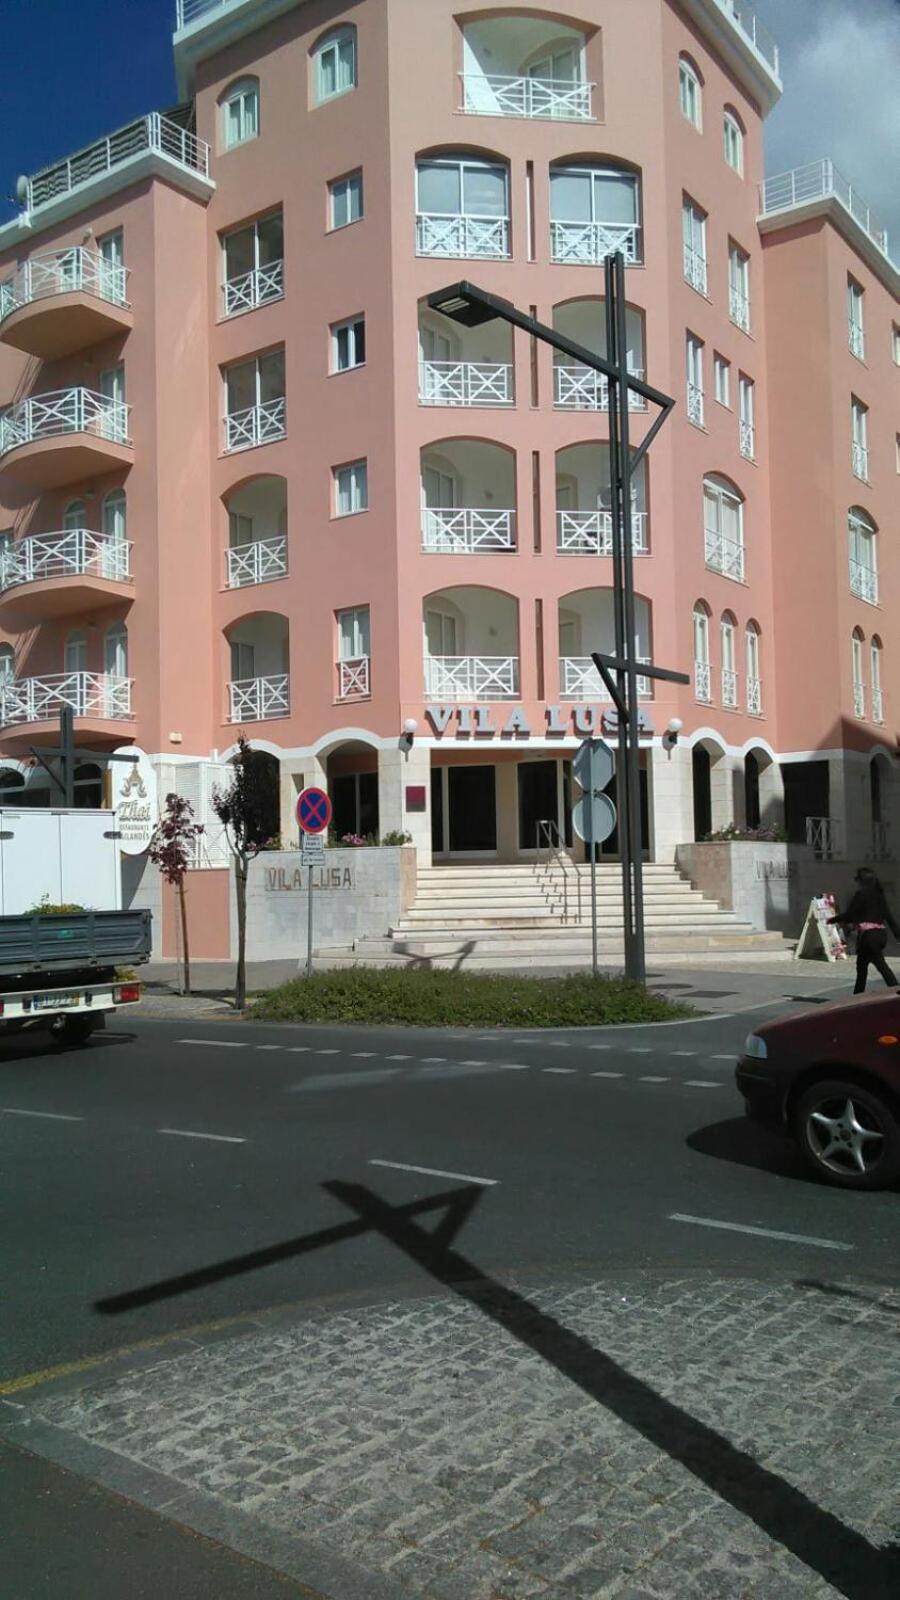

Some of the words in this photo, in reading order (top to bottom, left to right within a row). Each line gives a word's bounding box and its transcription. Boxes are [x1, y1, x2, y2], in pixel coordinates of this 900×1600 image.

[425, 704, 530, 736] VILA
[546, 704, 654, 737] LUSA
[268, 867, 302, 890] VILA
